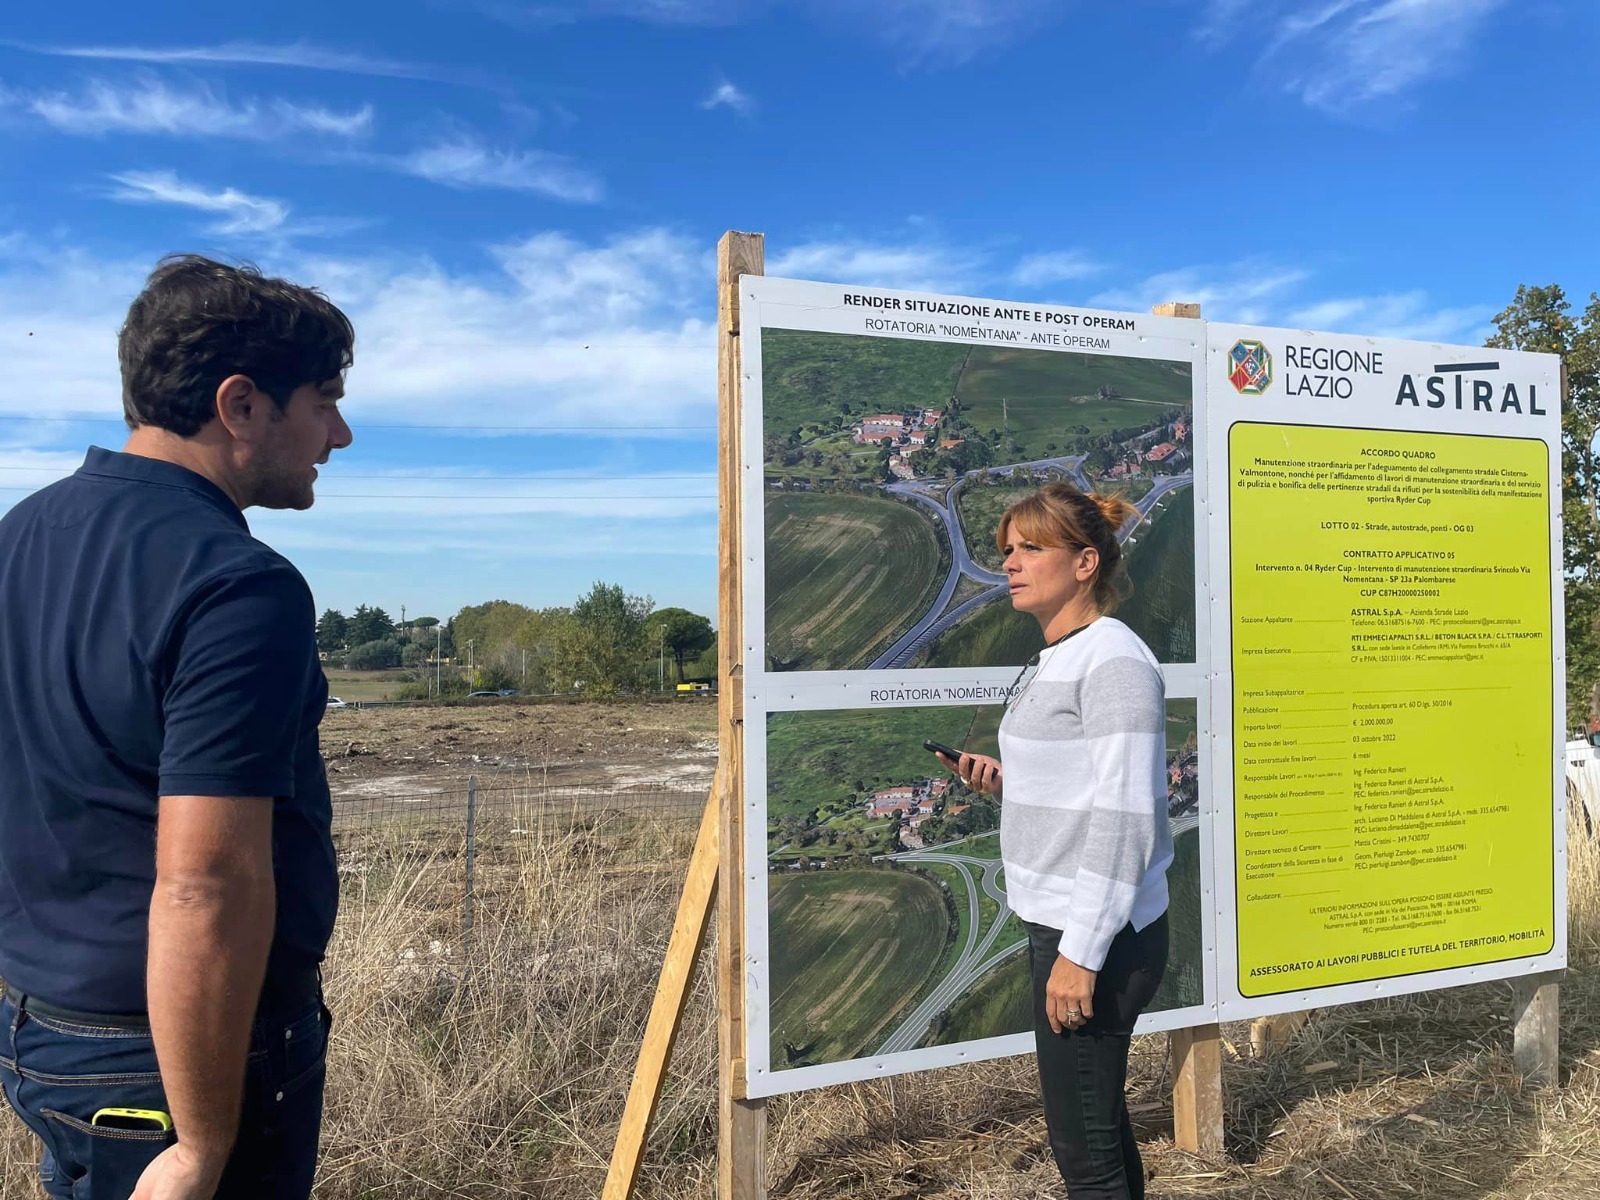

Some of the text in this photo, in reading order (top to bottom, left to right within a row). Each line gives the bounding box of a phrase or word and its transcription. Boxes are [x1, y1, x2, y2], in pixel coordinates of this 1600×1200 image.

[843, 293, 1135, 331] RENDER SITUAZIONE ANTE E POST OPERAM
[865, 318, 1110, 349] ROTATORIA "NOMENTANA" ANTE OPERAM
[1285, 345, 1383, 375] REGIONE
[1285, 373, 1353, 399] LAZIO
[1395, 361, 1547, 416] ASTRAL
[1360, 448, 1436, 460] ACCORDO QUADRO
[1254, 457, 1306, 468] Manutenzione
[1307, 460, 1353, 469] straordinaria
[1353, 463, 1366, 471] per
[1367, 462, 1418, 473] l'adeguamento
[1418, 464, 1429, 473] del
[1429, 465, 1474, 476] collegamento
[1474, 468, 1500, 476] stradale
[1239, 468, 1287, 479] Valmontone,
[1288, 470, 1315, 479] nonché
[1315, 472, 1329, 481] per
[1329, 471, 1375, 481] l'affidamento
[1375, 473, 1383, 481] di
[1383, 473, 1404, 482] lavori
[1404, 474, 1412, 483] di
[1412, 476, 1459, 485] manutenzione
[1460, 478, 1501, 486] straordinaria
[1506, 479, 1517, 487] del
[1517, 480, 1541, 488] servizio
[1237, 479, 1245, 487] di
[1246, 479, 1271, 489] pulizia
[1278, 480, 1307, 489] bonifica
[1307, 481, 1326, 490] delle
[1326, 482, 1365, 492] pertinenze
[1365, 484, 1391, 492] stradali
[1392, 485, 1401, 493] da
[1401, 485, 1421, 493] rifiuti
[1421, 487, 1434, 496] per
[1434, 486, 1441, 494] la
[1441, 487, 1480, 496] sostenibilità
[1480, 488, 1496, 496] della
[1496, 489, 1543, 498] manifestazione
[1366, 495, 1431, 506] sportiva Ryder Cup
[1320, 521, 1350, 530] LOTTO
[1350, 522, 1360, 530] 02
[1430, 524, 1448, 534] ponti
[1452, 524, 1465, 533] OG
[1465, 524, 1474, 533] 03
[1342, 550, 1455, 559] CONTRATTO APPLICATIVO 05
[1255, 563, 1295, 572] Intervento
[1304, 563, 1313, 572] 04
[1314, 563, 1336, 574] Ryder
[1336, 564, 1352, 574] Cup
[1357, 564, 1394, 573] Intervento
[1394, 564, 1402, 573] di
[1403, 565, 1451, 573] manutenzione
[1451, 565, 1493, 573] straordinaria
[1493, 565, 1520, 574] Svincolo
[1342, 575, 1456, 583] Nomentana SP 23a Palombarese
[1249, 929, 1545, 977] ASSESSORATO AI LAVORI PUBBLICI E TUTELA DEL TERRITORIO, MOBILITÀ
